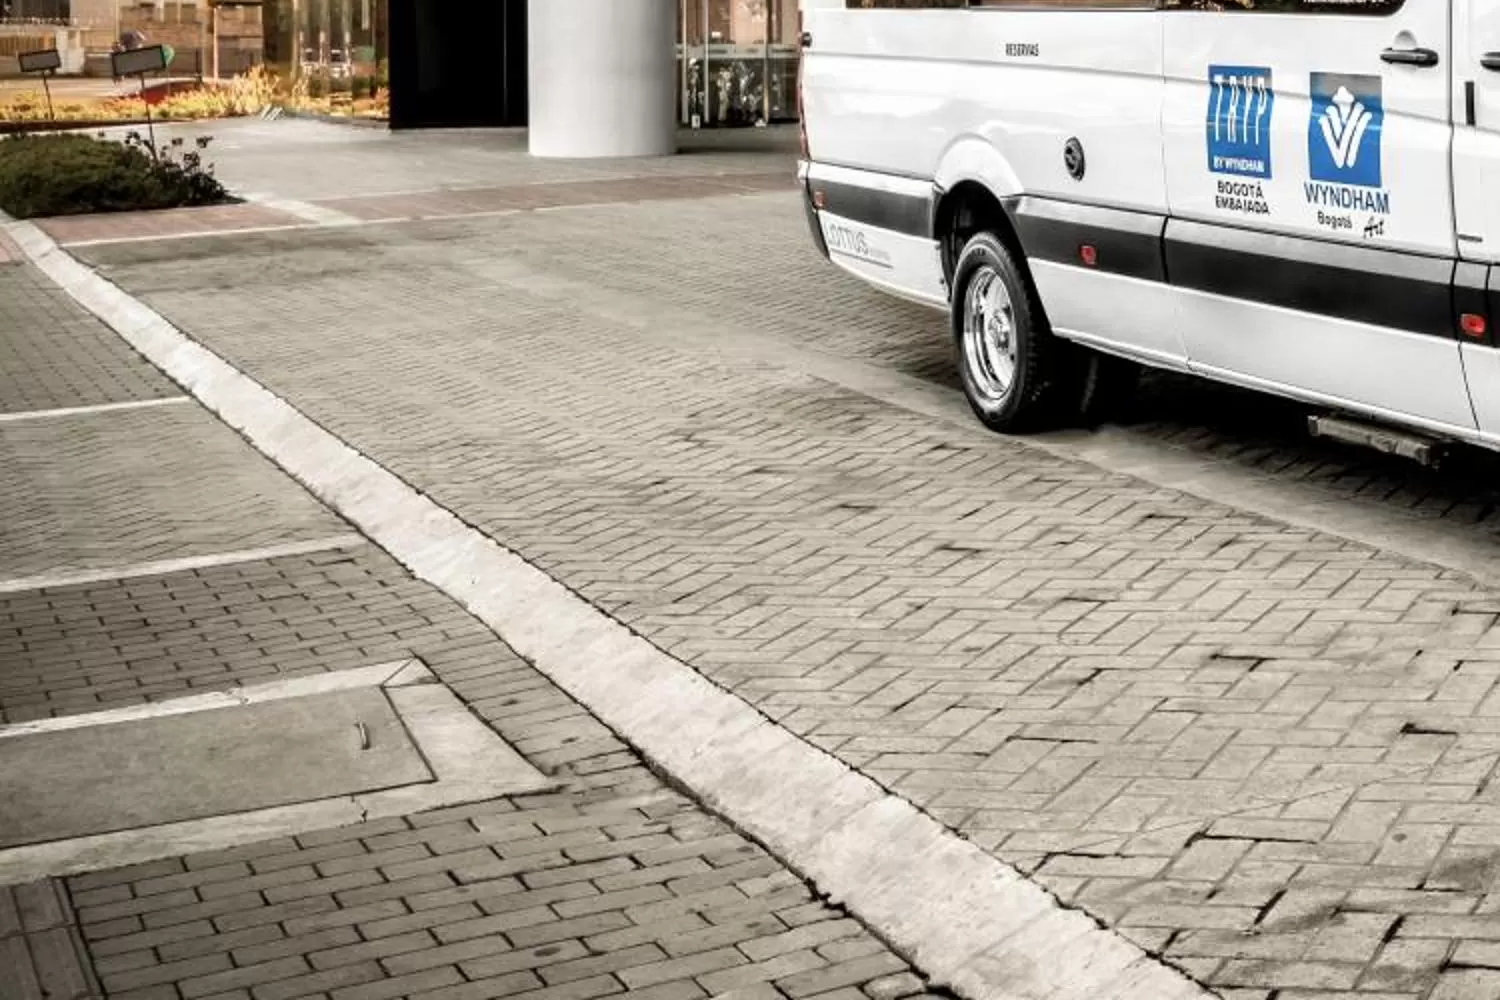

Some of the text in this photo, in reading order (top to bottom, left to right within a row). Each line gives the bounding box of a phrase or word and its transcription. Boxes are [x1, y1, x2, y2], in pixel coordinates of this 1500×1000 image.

[1213, 74, 1267, 145] TRYP
[1225, 157, 1265, 173] WYNDHAM
[1215, 195, 1270, 215] EMBAJADA
[1303, 181, 1391, 214] WYNDHAM
